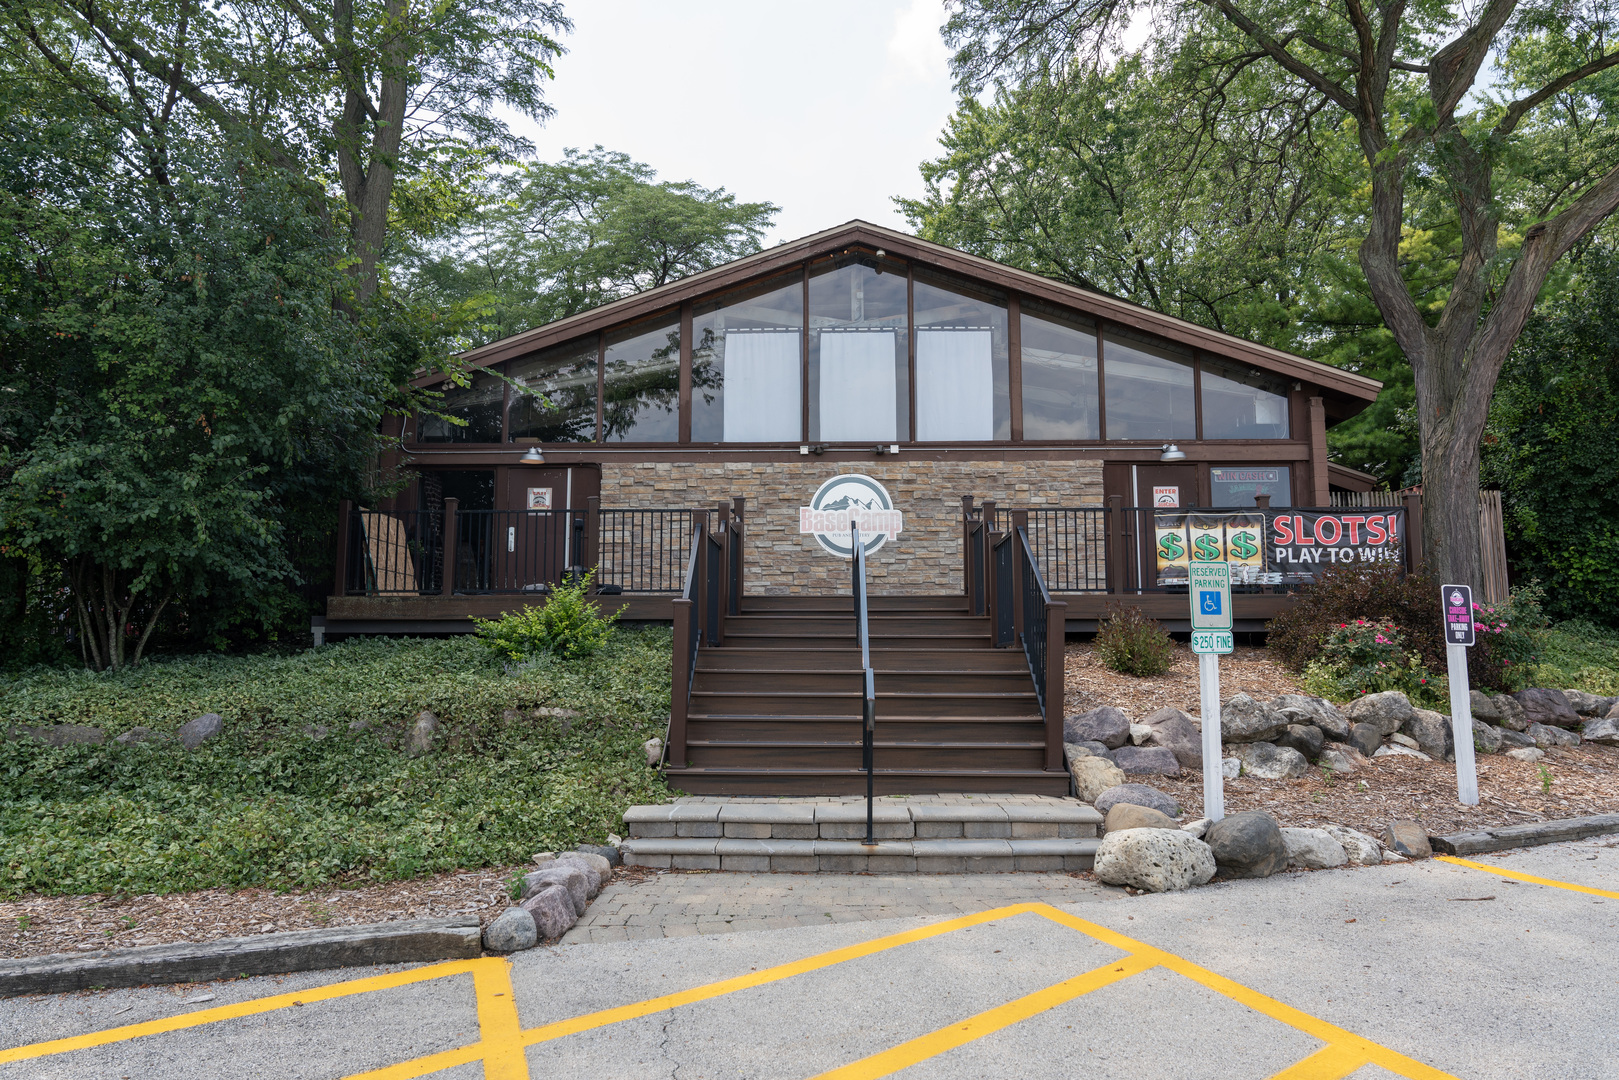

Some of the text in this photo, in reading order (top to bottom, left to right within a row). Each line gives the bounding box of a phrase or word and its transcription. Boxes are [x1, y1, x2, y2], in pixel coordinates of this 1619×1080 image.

[1217, 471, 1265, 480] WIN CASH
[801, 508, 901, 539] BaseCamp
[1273, 515, 1398, 545] SLOTS!
[1276, 548, 1323, 563] PLAY
[1327, 548, 1354, 563] TO
[1192, 568, 1226, 576] RESERVED
[1194, 579, 1225, 588] PARKING
[1450, 622, 1468, 631] PARKING
[1455, 631, 1465, 640] ONLY
[1194, 636, 1232, 648] $250 FINE
